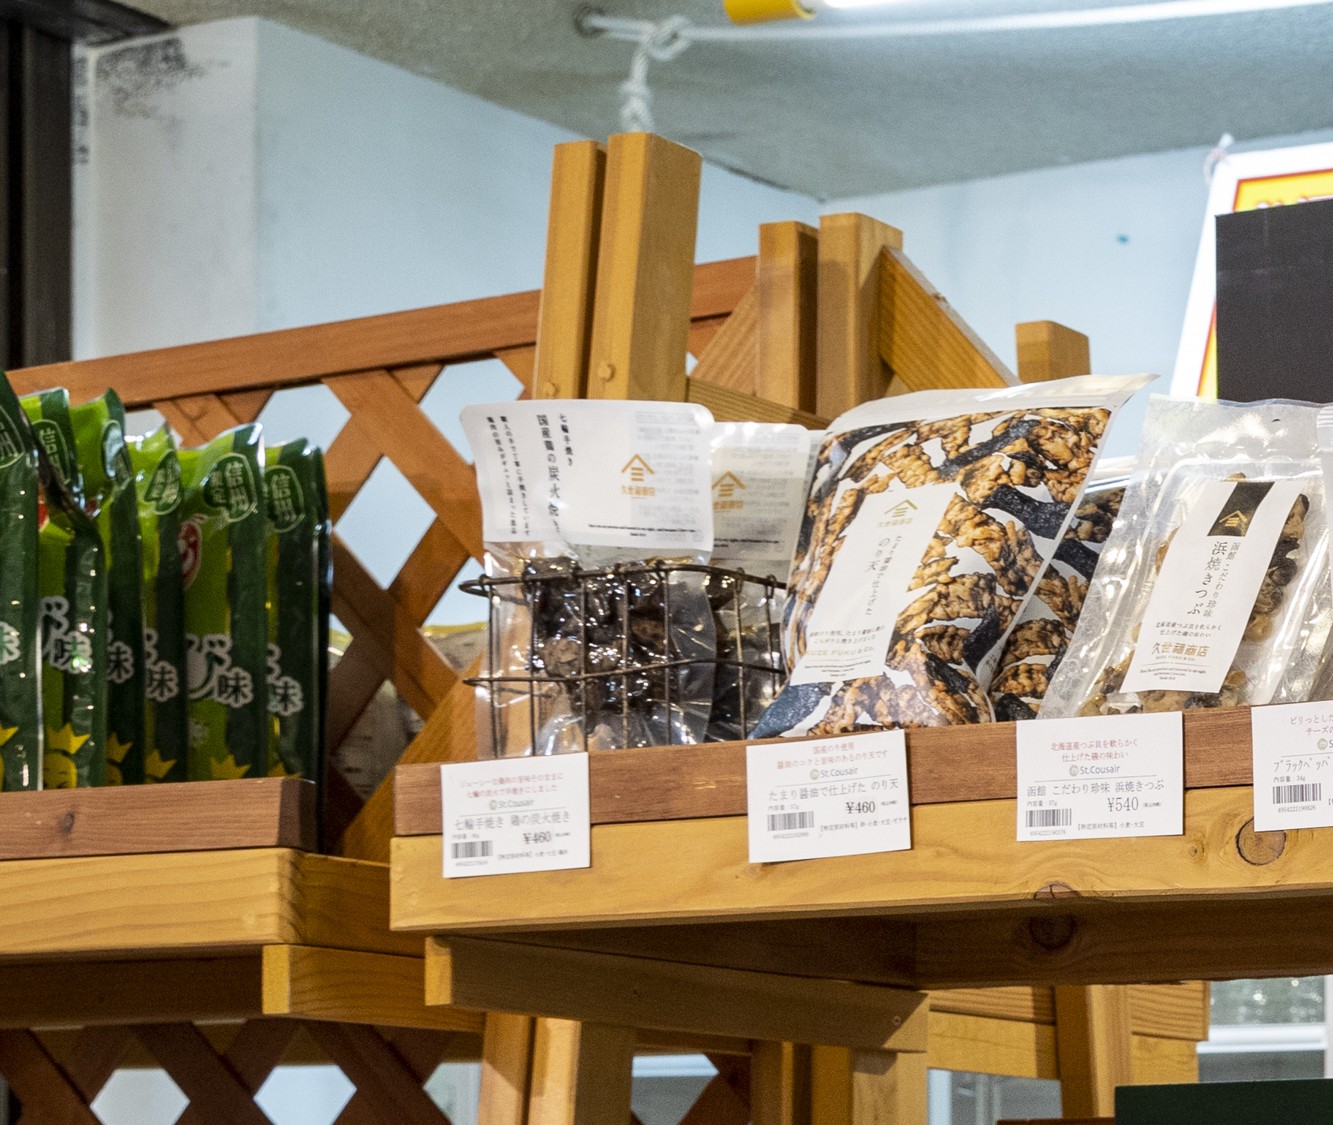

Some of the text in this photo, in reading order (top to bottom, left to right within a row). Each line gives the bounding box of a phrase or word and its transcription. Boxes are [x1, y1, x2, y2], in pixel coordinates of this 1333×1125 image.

[1080, 764, 1120, 776] St.Cousair
[871, 779, 899, 792] のり天
[1027, 779, 1165, 797] 函館 こだわり珍味 浜焼きつぶ
[845, 801, 876, 815] ¥460
[1107, 797, 1139, 811] ¥540
[522, 832, 552, 844] ¥460
